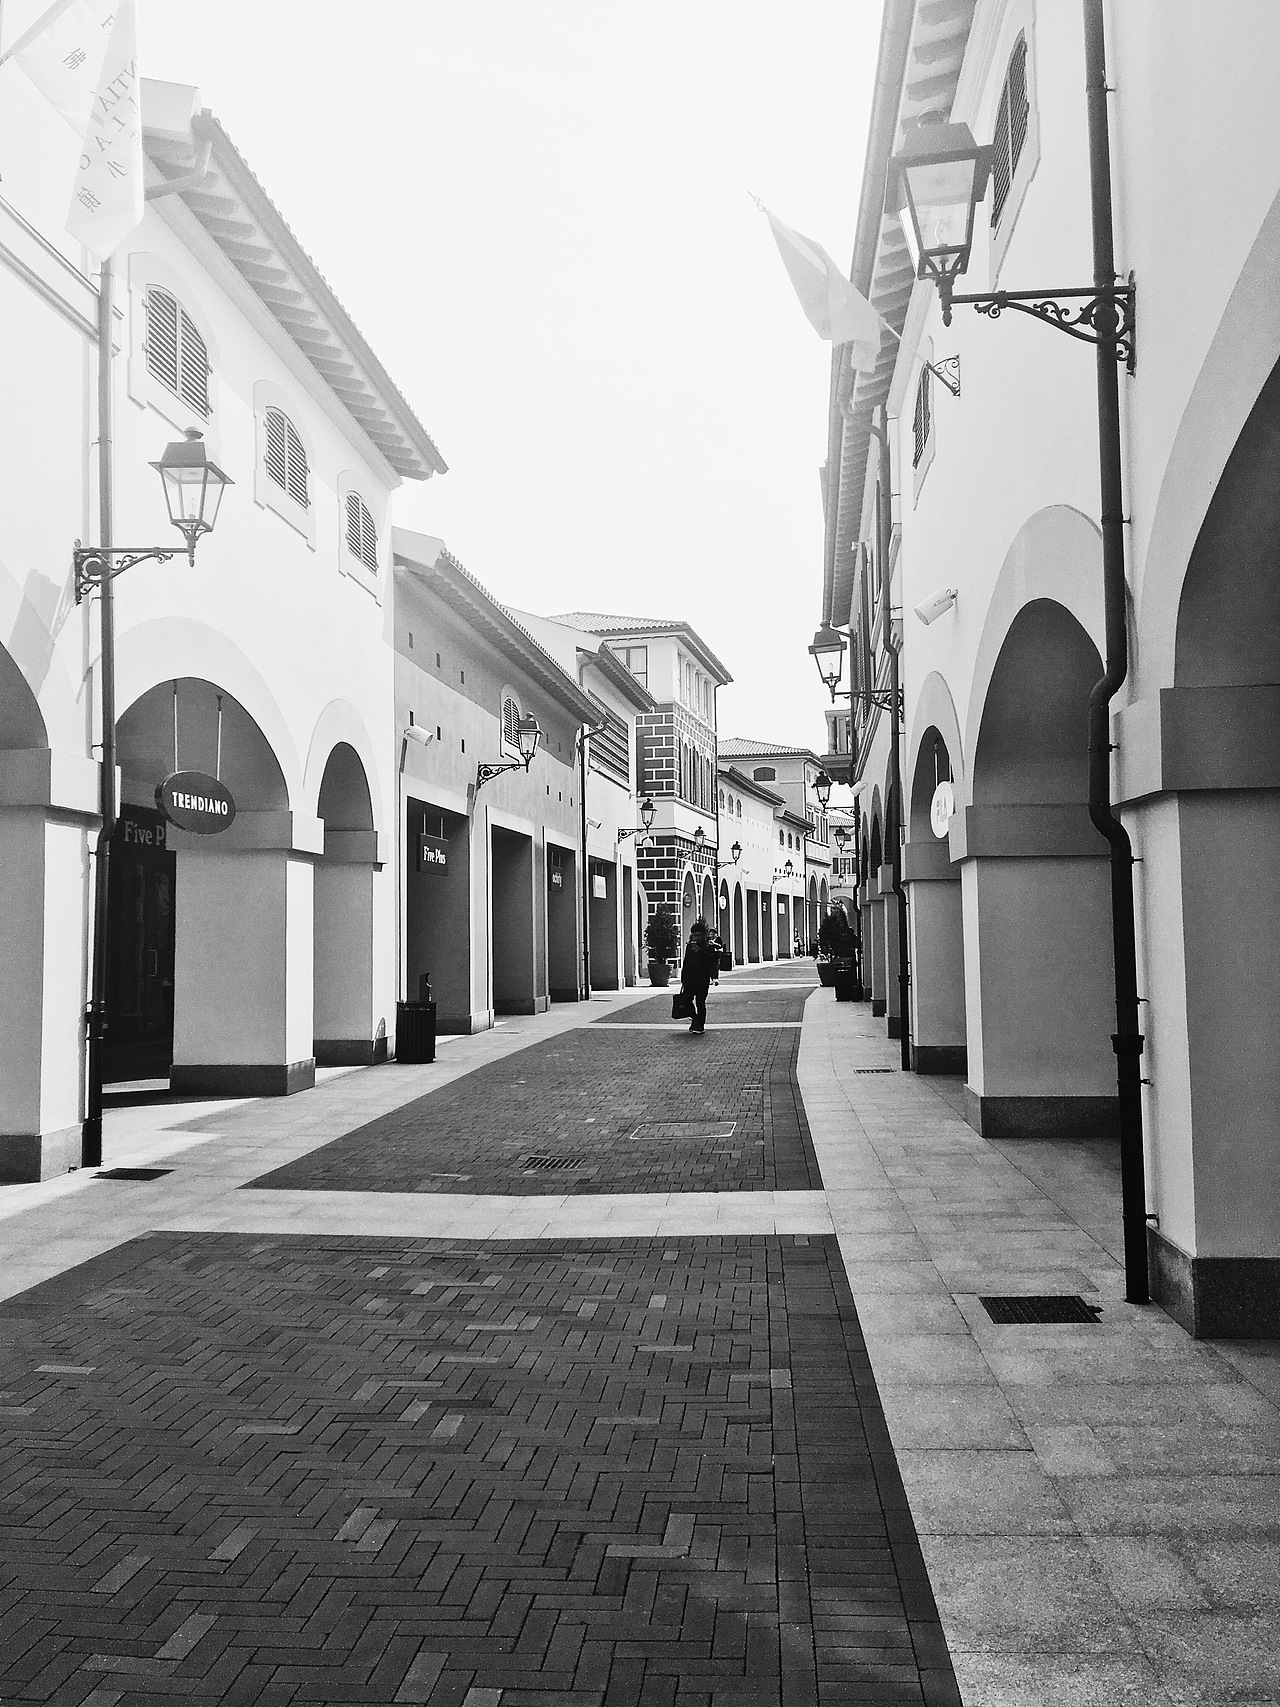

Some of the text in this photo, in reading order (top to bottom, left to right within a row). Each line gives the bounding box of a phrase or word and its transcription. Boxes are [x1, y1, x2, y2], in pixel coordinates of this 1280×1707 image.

[171, 791, 229, 816] TRENDIANO
[123, 820, 166, 846] Five P
[423, 845, 446, 865] Five Plus
